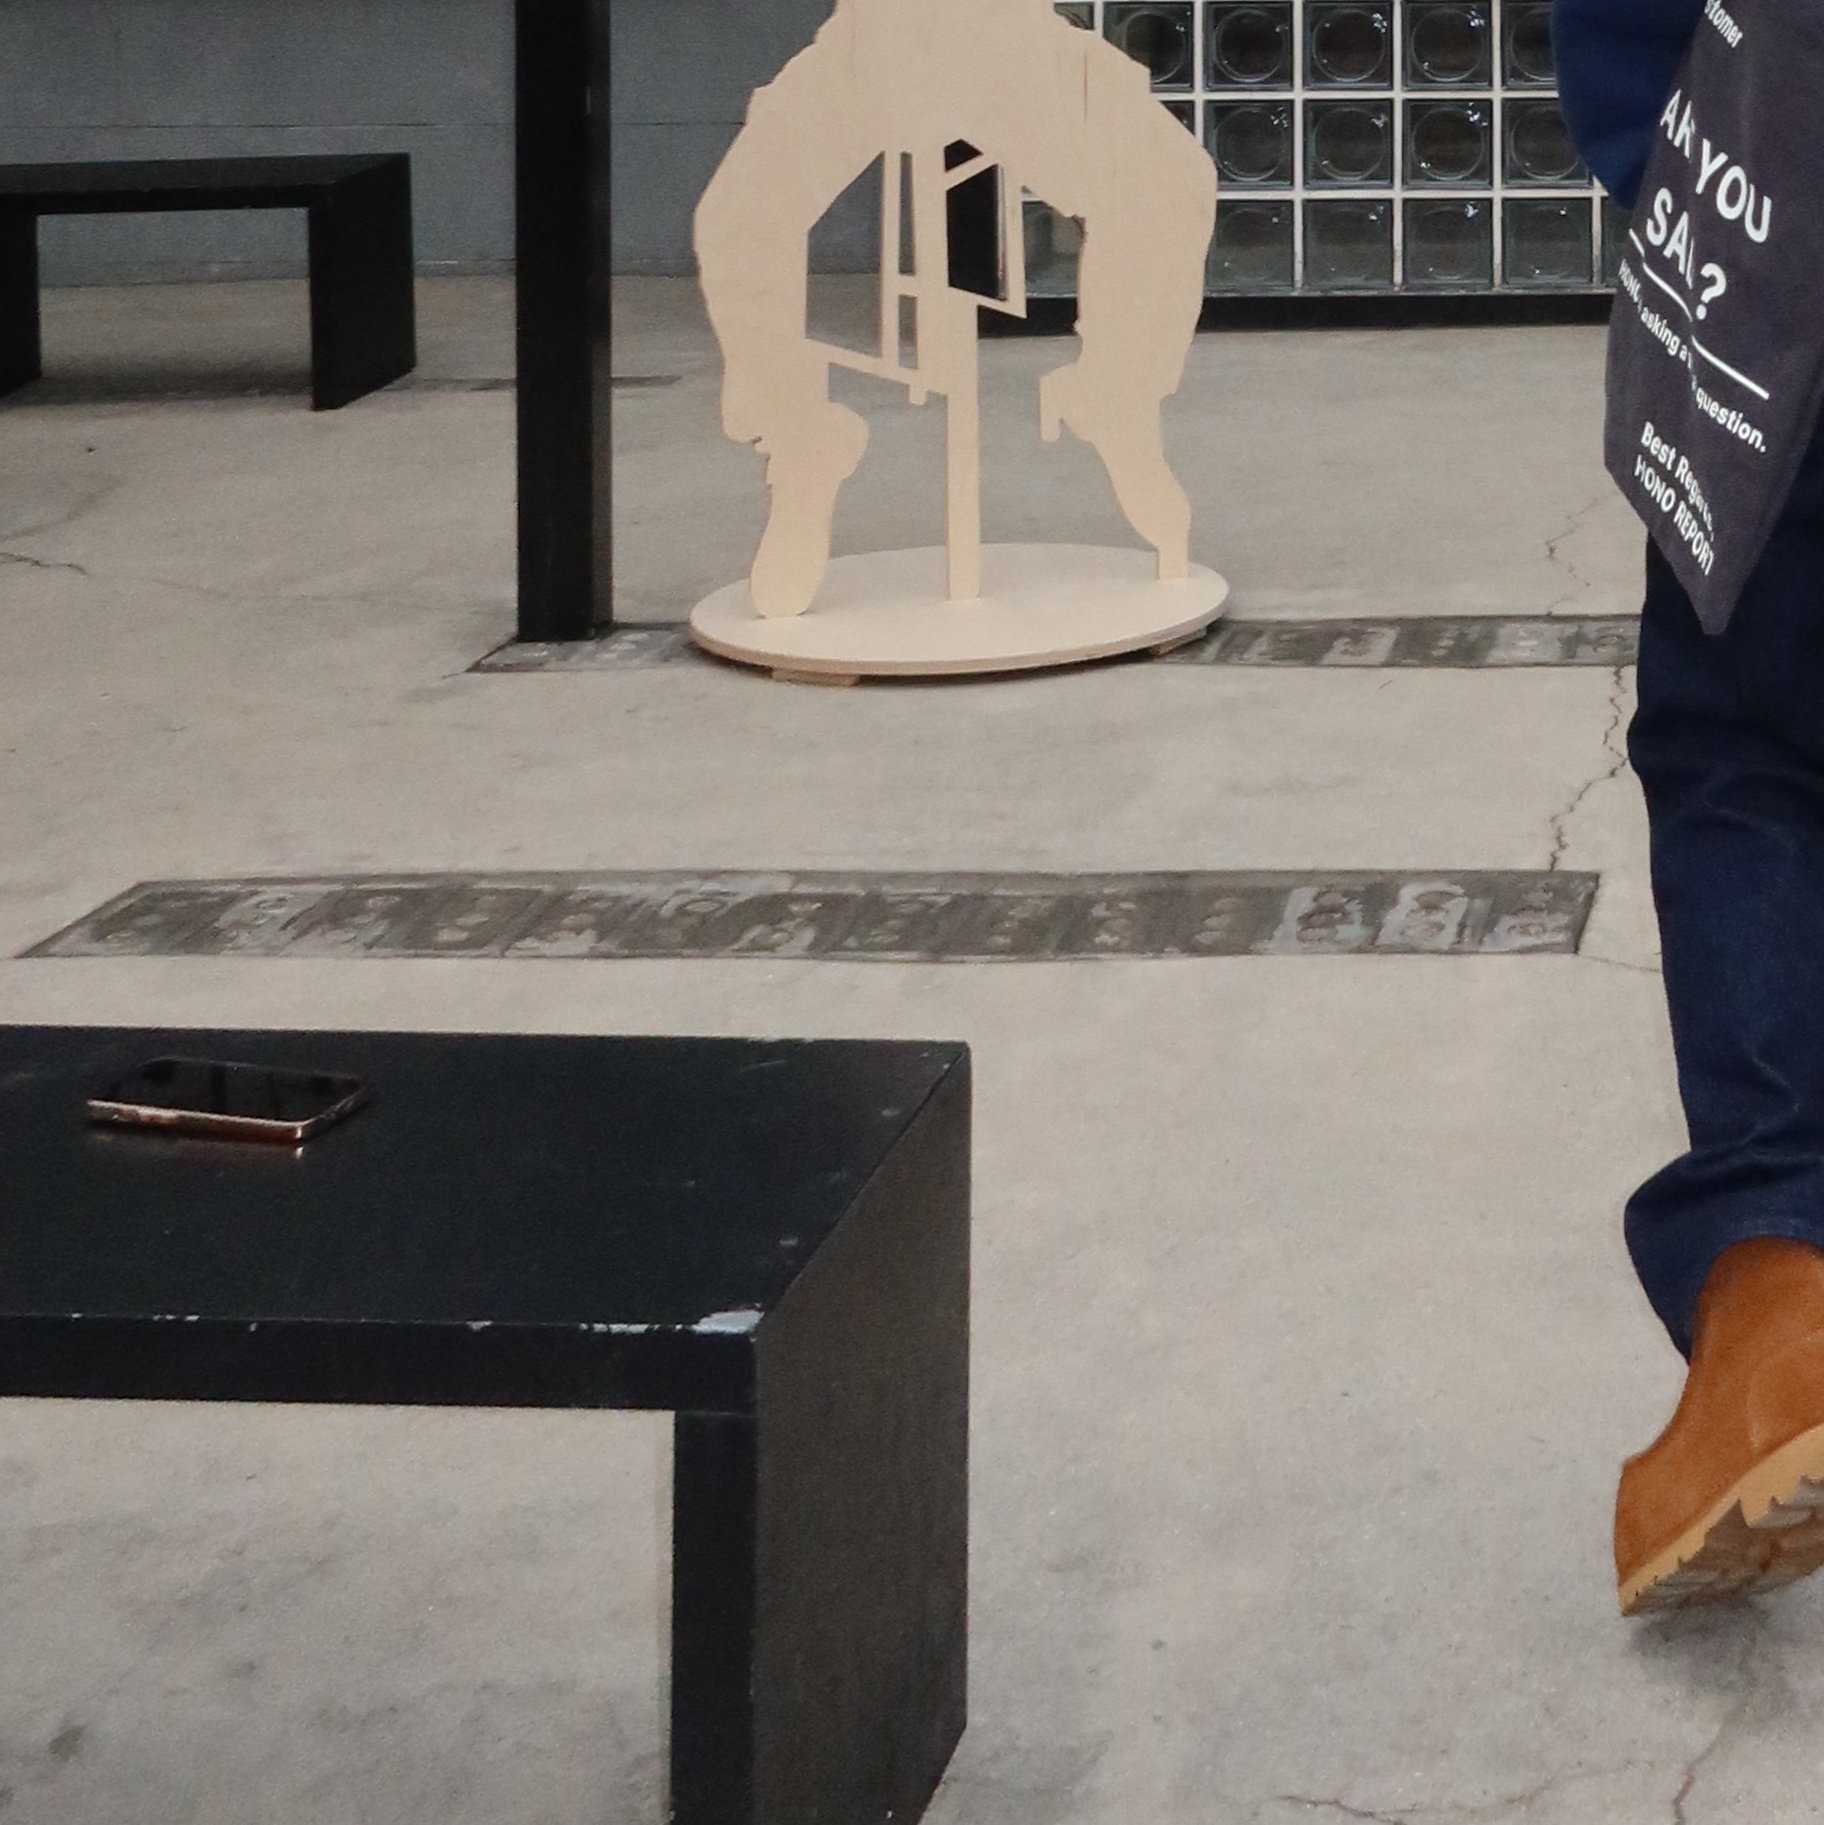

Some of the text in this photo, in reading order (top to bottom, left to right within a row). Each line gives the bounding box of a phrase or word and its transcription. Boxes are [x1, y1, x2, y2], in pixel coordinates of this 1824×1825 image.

[1695, 137, 1772, 243] YOU
[1640, 306, 1681, 357] asking
[1640, 420, 1677, 471] Best
[1634, 453, 1677, 513] HONO
